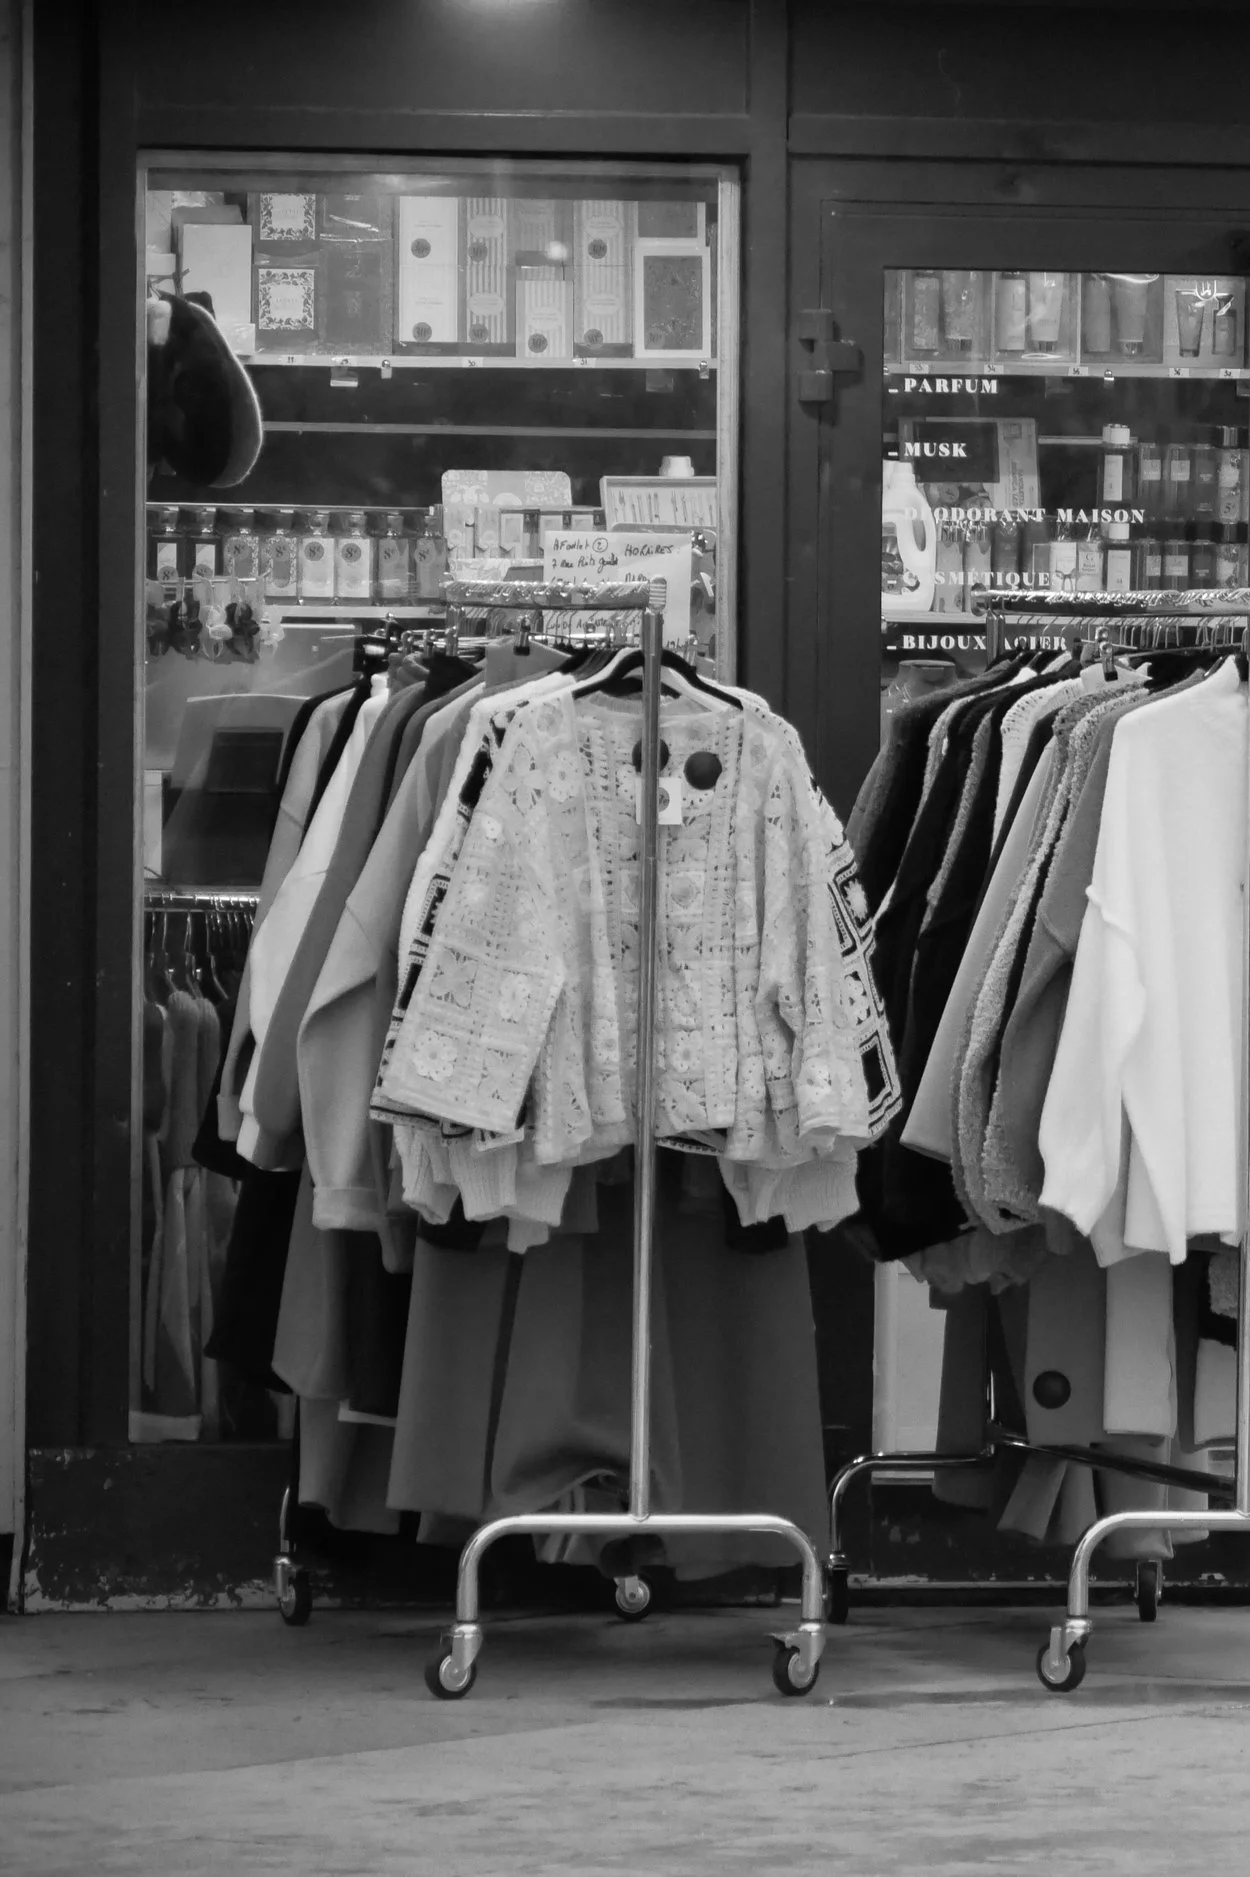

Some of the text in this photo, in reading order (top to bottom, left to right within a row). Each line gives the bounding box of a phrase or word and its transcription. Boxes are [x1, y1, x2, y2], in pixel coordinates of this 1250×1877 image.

[904, 377, 998, 394] PARFUM
[904, 442, 967, 457] MUSK
[904, 507, 1146, 524] DODORANT MAISON
[903, 635, 986, 651] BIJOUX
